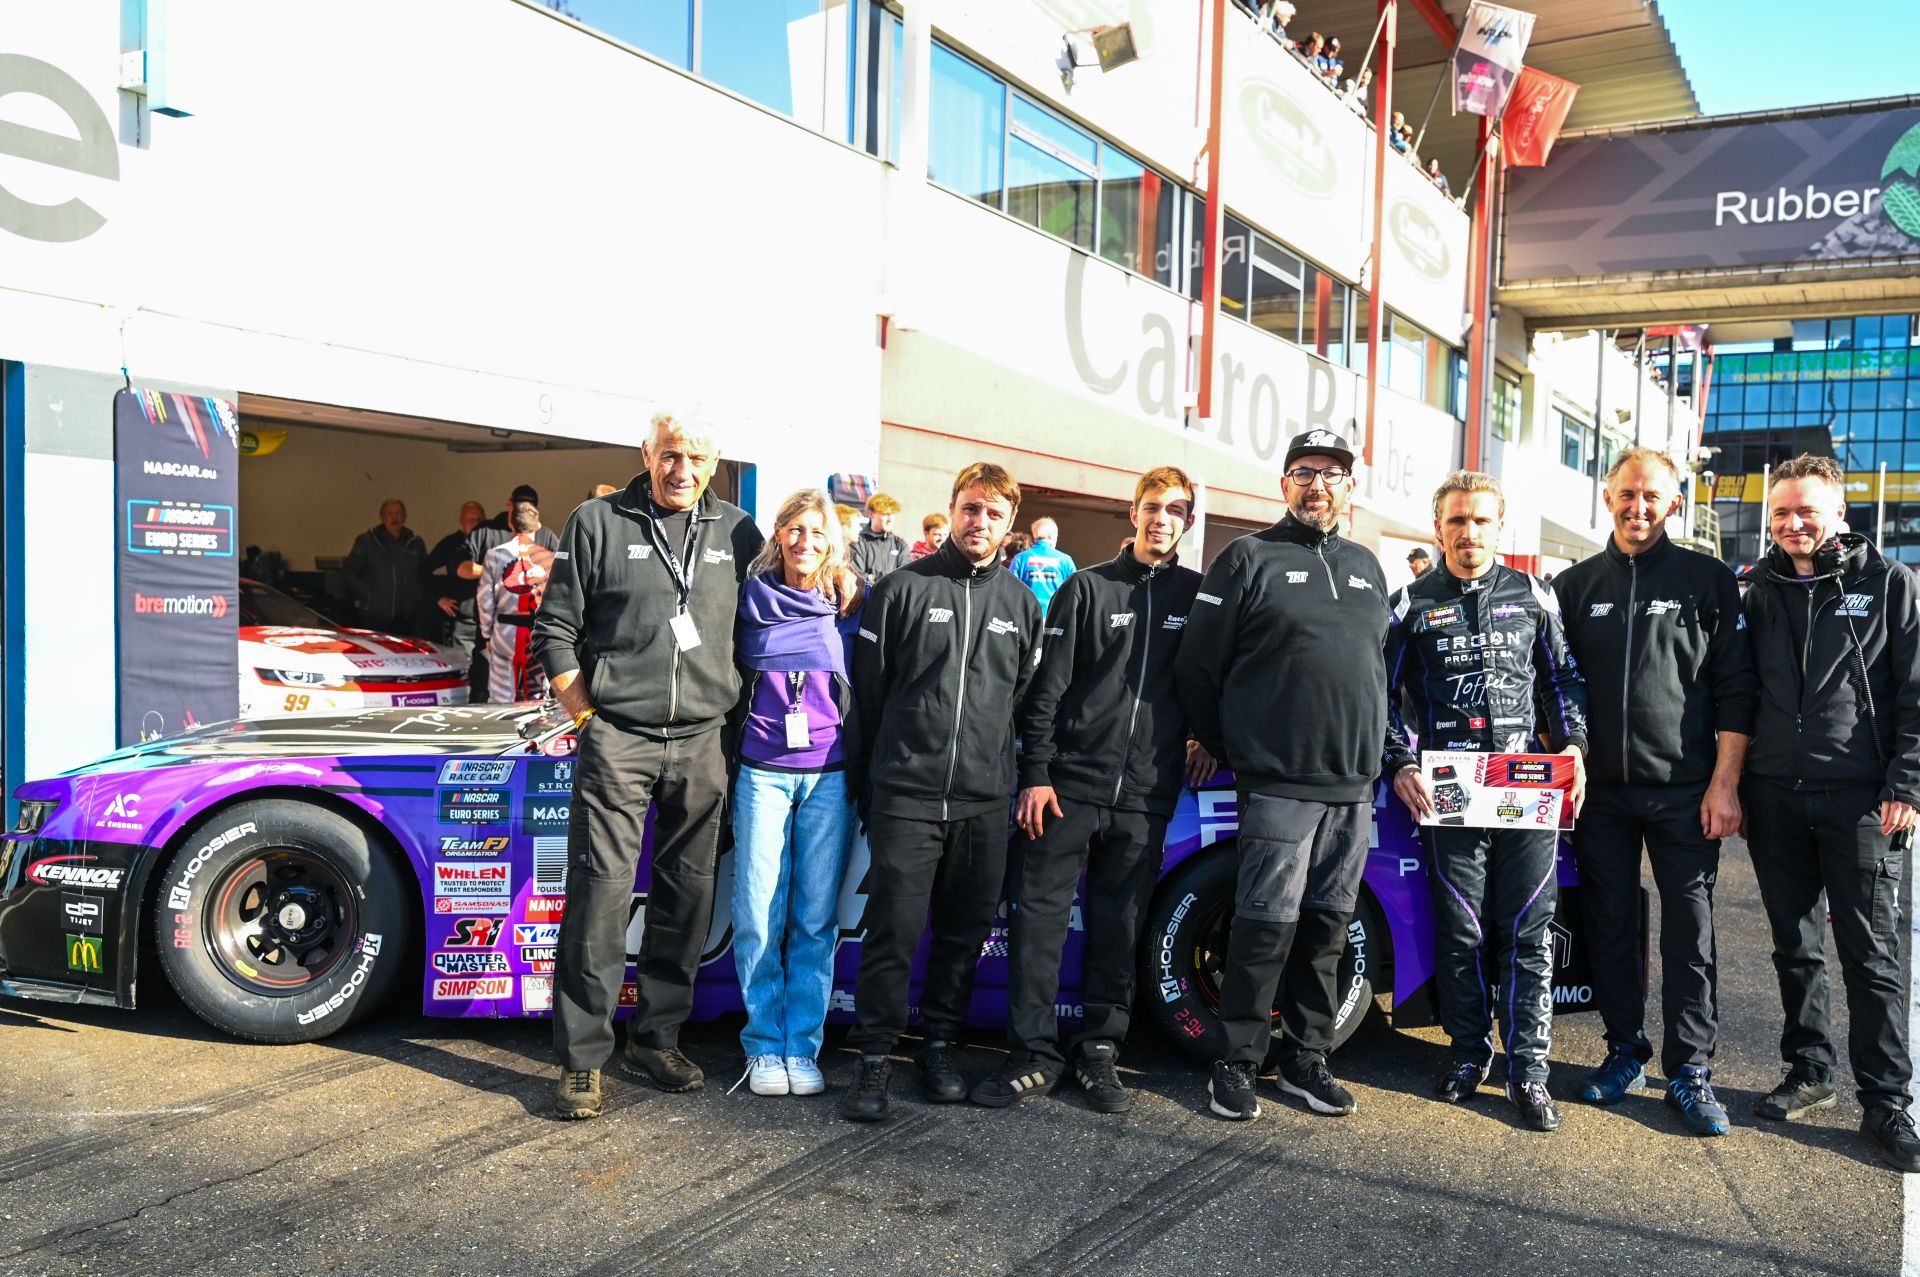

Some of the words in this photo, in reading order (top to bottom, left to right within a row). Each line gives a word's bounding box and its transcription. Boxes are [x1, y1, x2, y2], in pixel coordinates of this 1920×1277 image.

[1715, 185, 1881, 226] Rubber
[144, 461, 217, 479] NASCAR.eu
[164, 508, 217, 526] NASCAR
[145, 532, 177, 547] EURO
[179, 533, 218, 549] SERIES
[135, 592, 214, 614] bremotion
[1841, 594, 1874, 610] THT
[1444, 650, 1497, 664] PROJECT
[283, 694, 310, 712] 99
[464, 762, 505, 772] NASCAR
[1474, 755, 1486, 784] OPEN
[449, 773, 476, 781] RACE
[479, 773, 500, 781] CAR
[1528, 773, 1545, 781] SERIES
[463, 793, 500, 803] NASCAR
[449, 809, 472, 819] EURO
[473, 809, 500, 819] SERIES
[1536, 790, 1552, 825] POLE
[177, 821, 258, 890] HOOSIER
[32, 863, 122, 884] KENNOL
[437, 865, 507, 880] WHELEN
[1160, 892, 1198, 980] HOOSIER
[434, 953, 505, 967] QUARTER
[446, 961, 508, 973] MASTER
[297, 953, 374, 1025] HOOSIER
[437, 979, 508, 997] SIMPSON
